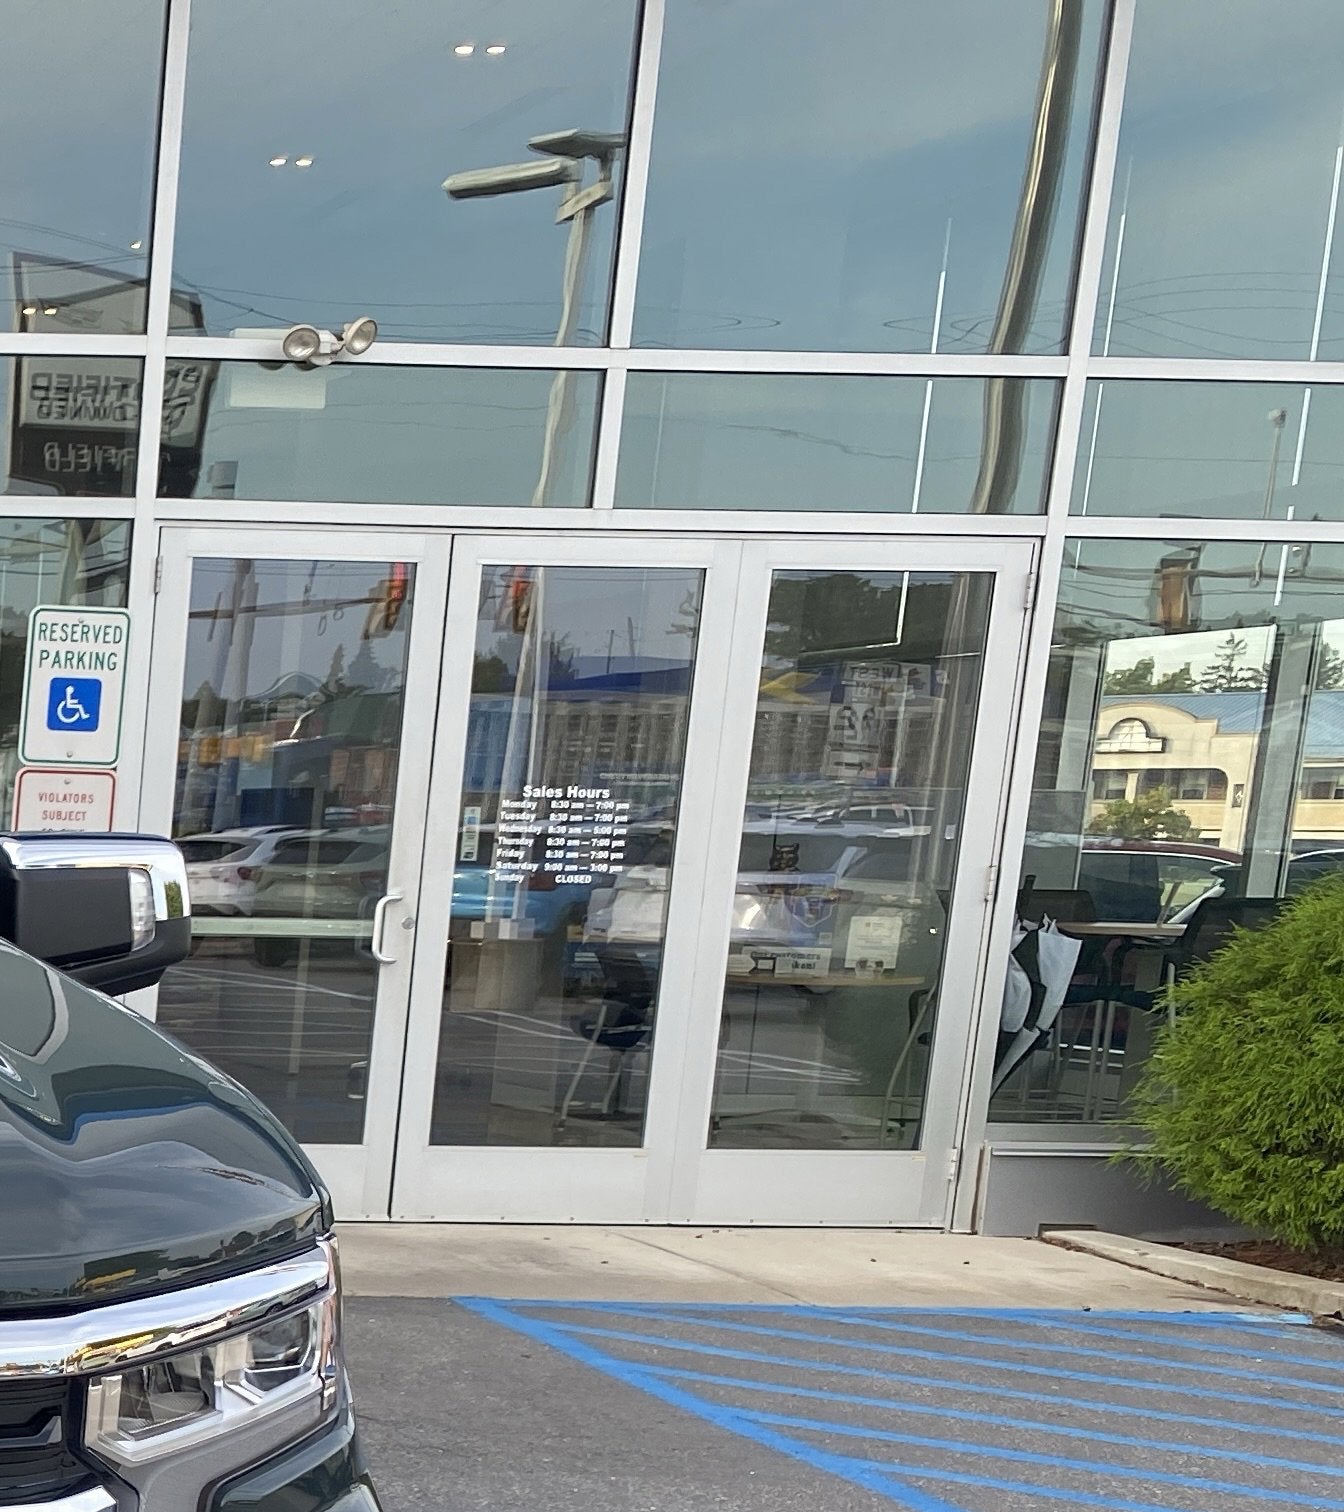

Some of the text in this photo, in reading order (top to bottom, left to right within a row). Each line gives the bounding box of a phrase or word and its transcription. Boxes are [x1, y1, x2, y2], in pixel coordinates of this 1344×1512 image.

[38, 622, 123, 645] RESERVED
[39, 649, 118, 671] PARKING
[523, 785, 610, 799] Sales Hours
[39, 792, 94, 804] VIOLATORS
[502, 800, 538, 810] Monday
[616, 803, 630, 811] pm
[42, 810, 87, 821] SUBJECT
[500, 812, 536, 822] Tuesday
[614, 815, 628, 823] pm
[613, 828, 627, 836] pm
[612, 840, 625, 848] pm
[496, 849, 526, 859] Friday
[610, 853, 624, 861] pm
[496, 861, 539, 872] Saturday
[609, 865, 623, 874] pm
[555, 875, 593, 883] CLOSED
